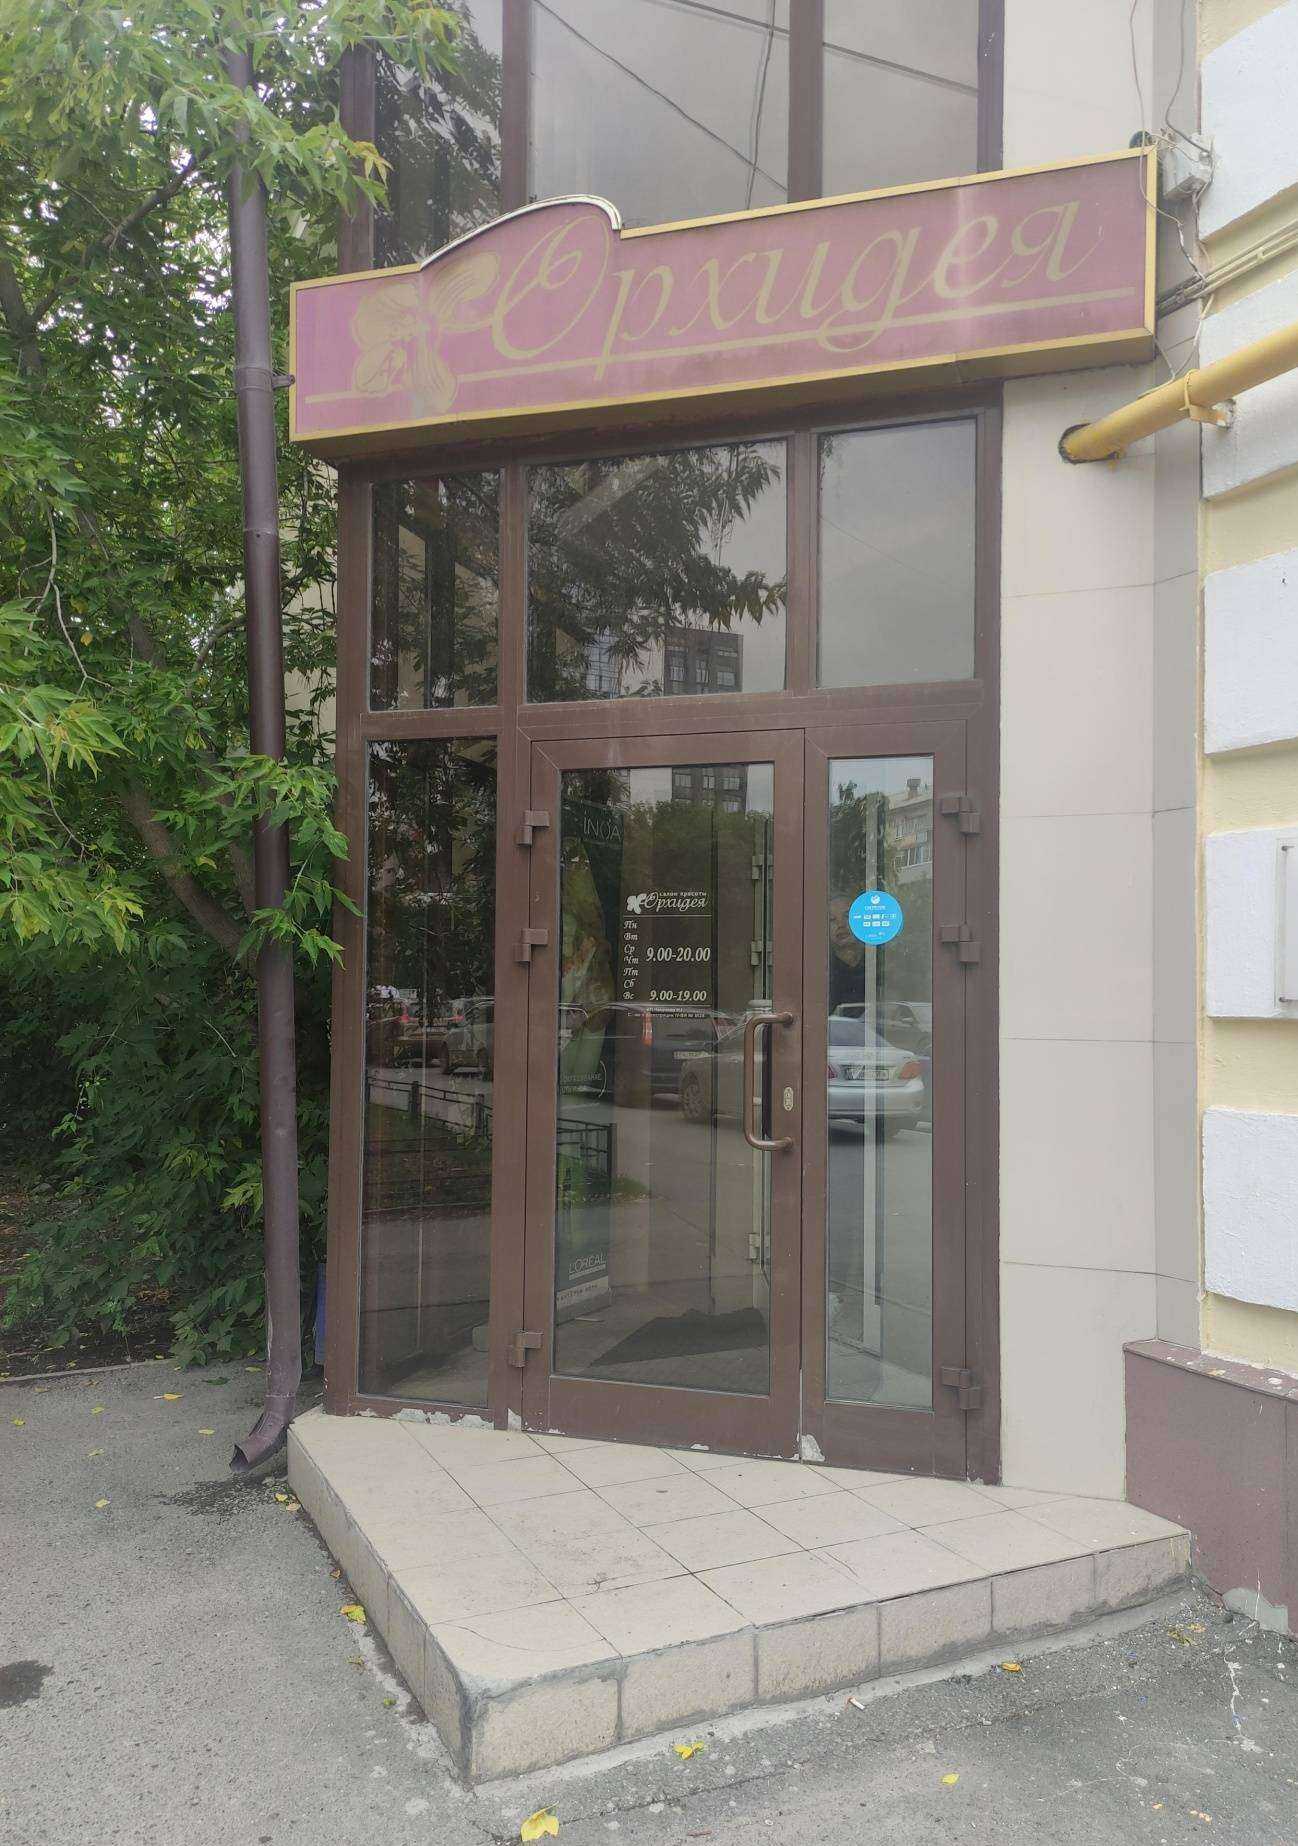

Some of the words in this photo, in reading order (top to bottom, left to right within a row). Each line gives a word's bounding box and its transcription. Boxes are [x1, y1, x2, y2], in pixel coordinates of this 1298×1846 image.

[491, 200, 1103, 381] Орхидея
[644, 892, 708, 912] Орхидея
[624, 944, 635, 954] Ср
[646, 947, 711, 962] 9.00-20.00
[623, 955, 639, 965] Чт
[623, 967, 639, 976] Пт
[623, 978, 636, 988] Сб
[623, 991, 634, 1000] Вс
[649, 990, 707, 1001] 9.00-19.00
